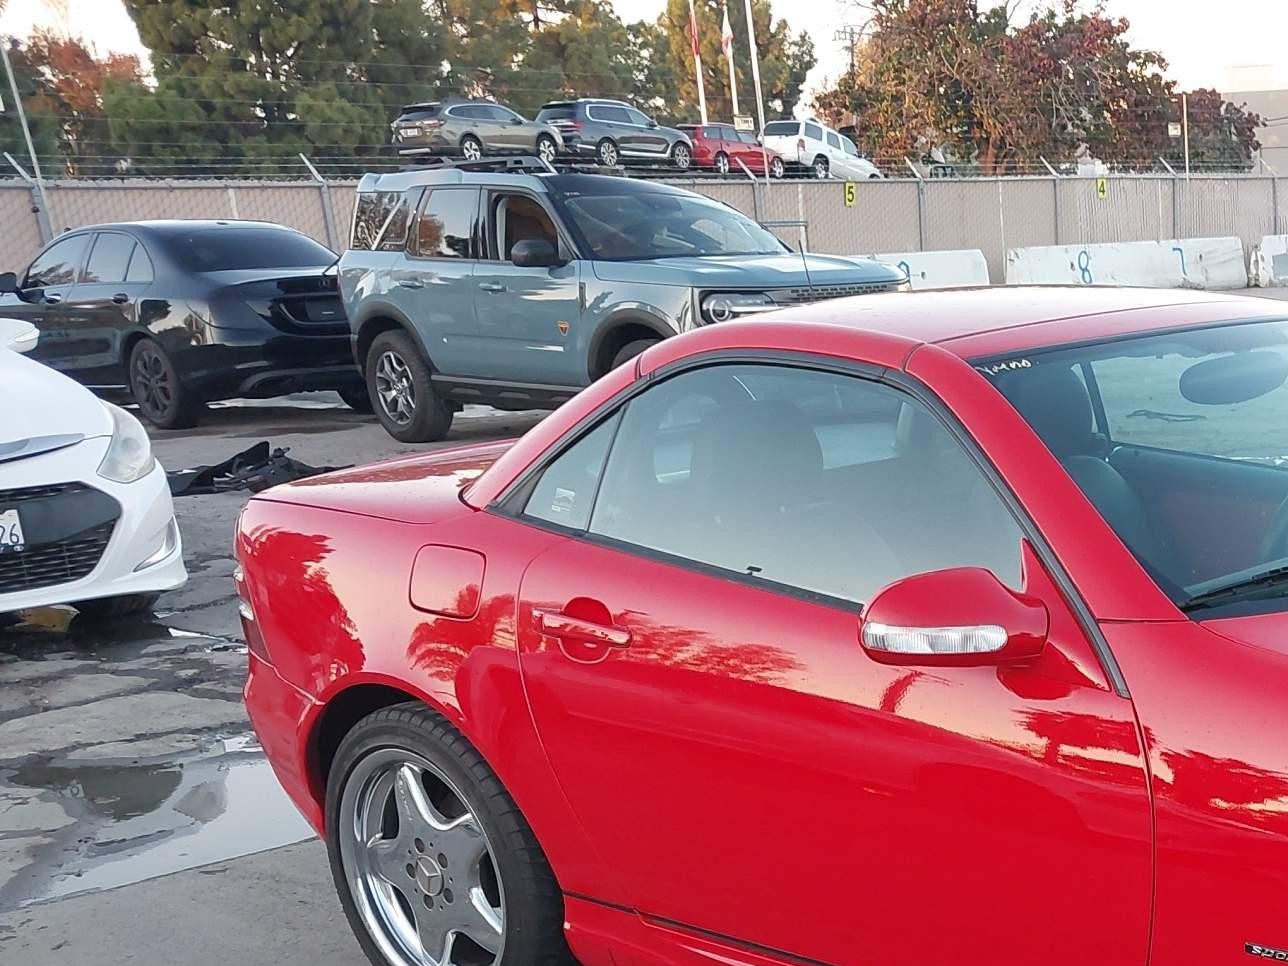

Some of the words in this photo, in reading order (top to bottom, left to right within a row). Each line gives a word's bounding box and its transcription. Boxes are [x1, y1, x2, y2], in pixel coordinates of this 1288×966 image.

[847, 185, 855, 203] 5
[1099, 180, 1105, 196] 4
[1078, 250, 1092, 284] 8
[1172, 247, 1187, 276] 7
